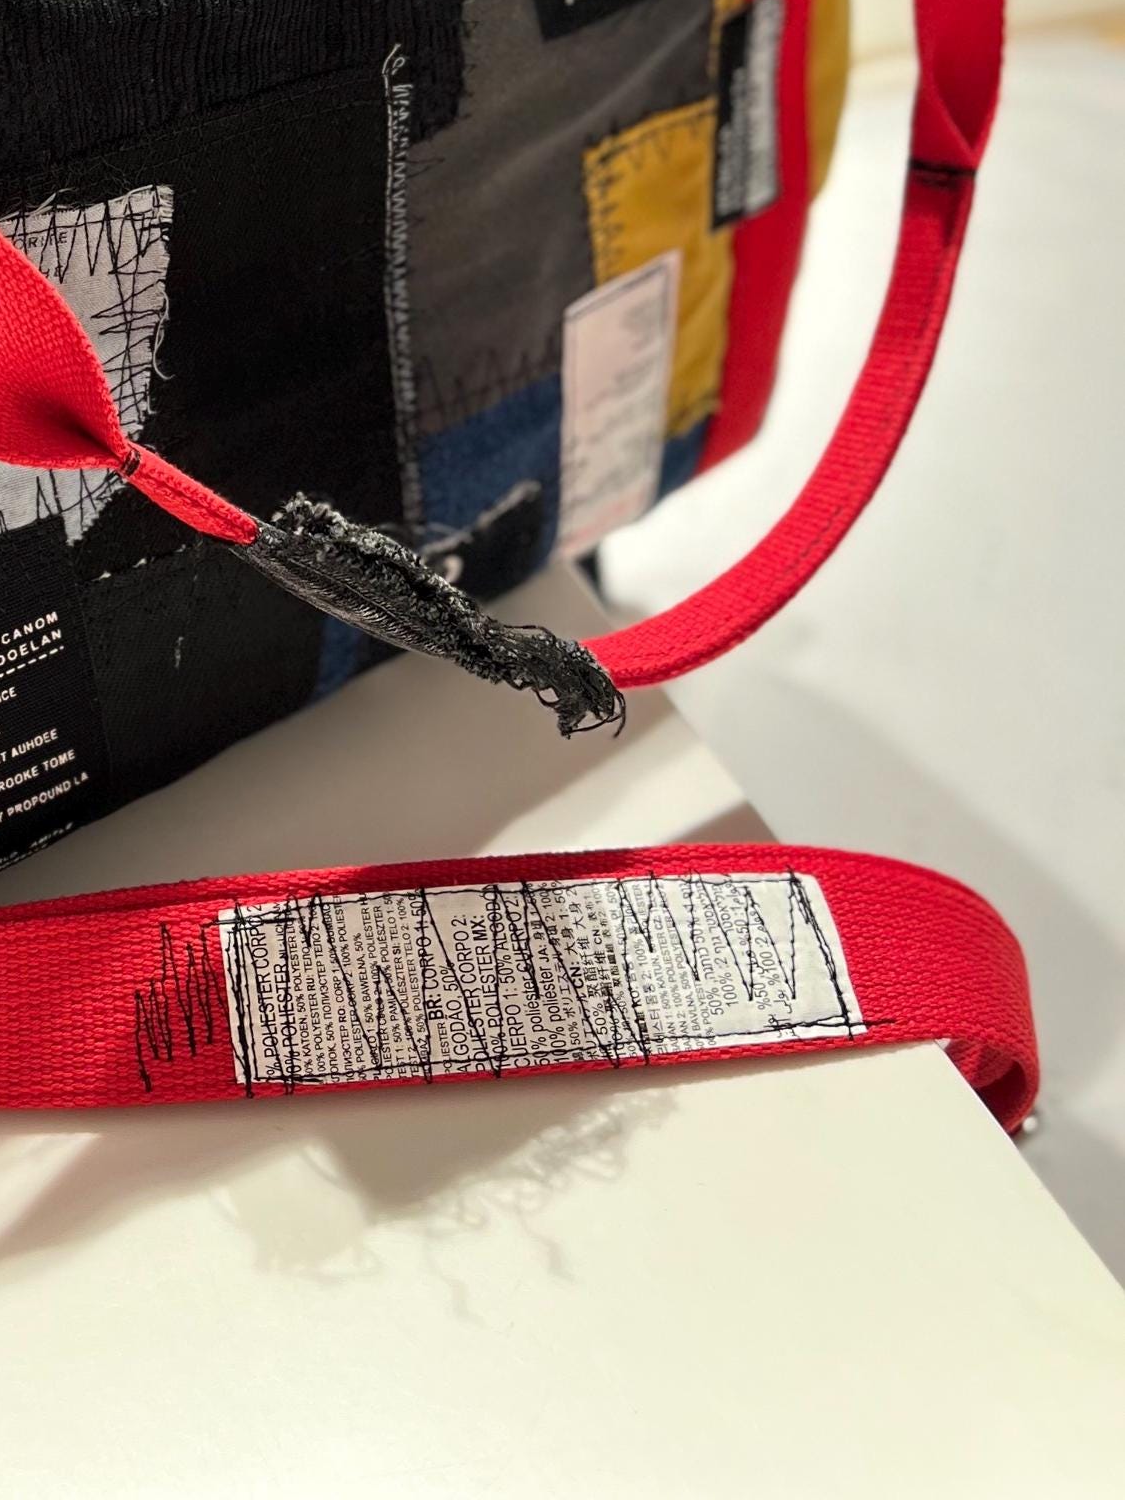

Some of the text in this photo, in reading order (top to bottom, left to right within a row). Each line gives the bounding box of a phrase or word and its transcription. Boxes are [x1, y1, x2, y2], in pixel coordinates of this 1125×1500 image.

[42, 748, 75, 772] TOME
[6, 779, 71, 817] PROPOUND
[73, 770, 87, 785] LA
[396, 897, 408, 920] 100%
[469, 914, 487, 941] MX:
[340, 943, 351, 966] 100%
[352, 932, 362, 951] 50%
[361, 907, 376, 958] POLIESTER
[371, 906, 389, 962] POLIÉSZTER
[387, 915, 400, 954] SI: TELO
[402, 933, 413, 956] TELO
[451, 914, 476, 983] CORPO 2:
[536, 944, 550, 962] JA:
[630, 938, 647, 967] 100%
[415, 935, 444, 1019] BR: CORPO
[567, 901, 608, 1035] 50% 聚酯纤维 大身
[567, 960, 583, 988] CN:
[656, 931, 676, 982] POLIESTER
[286, 935, 311, 1056] KATOEN, 50% POLYESTER
[311, 932, 334, 1041] 50% ПОЛИЭСТЕР ТЕЛО
[332, 975, 346, 1022] RO: CORP
[406, 958, 422, 1011] POLIESTER
[535, 965, 562, 1022] poliéster
[254, 972, 280, 1057] POLIESTER
[305, 974, 323, 1050] POLYESTER RU:
[363, 1003, 373, 1023] 50%
[391, 1023, 401, 1042] 50%
[414, 1012, 425, 1032] 50%
[439, 961, 471, 1073] ALGODÃO, 50%
[495, 954, 530, 1067] CUERPO 1: 50%
[565, 1021, 579, 1045] 50%
